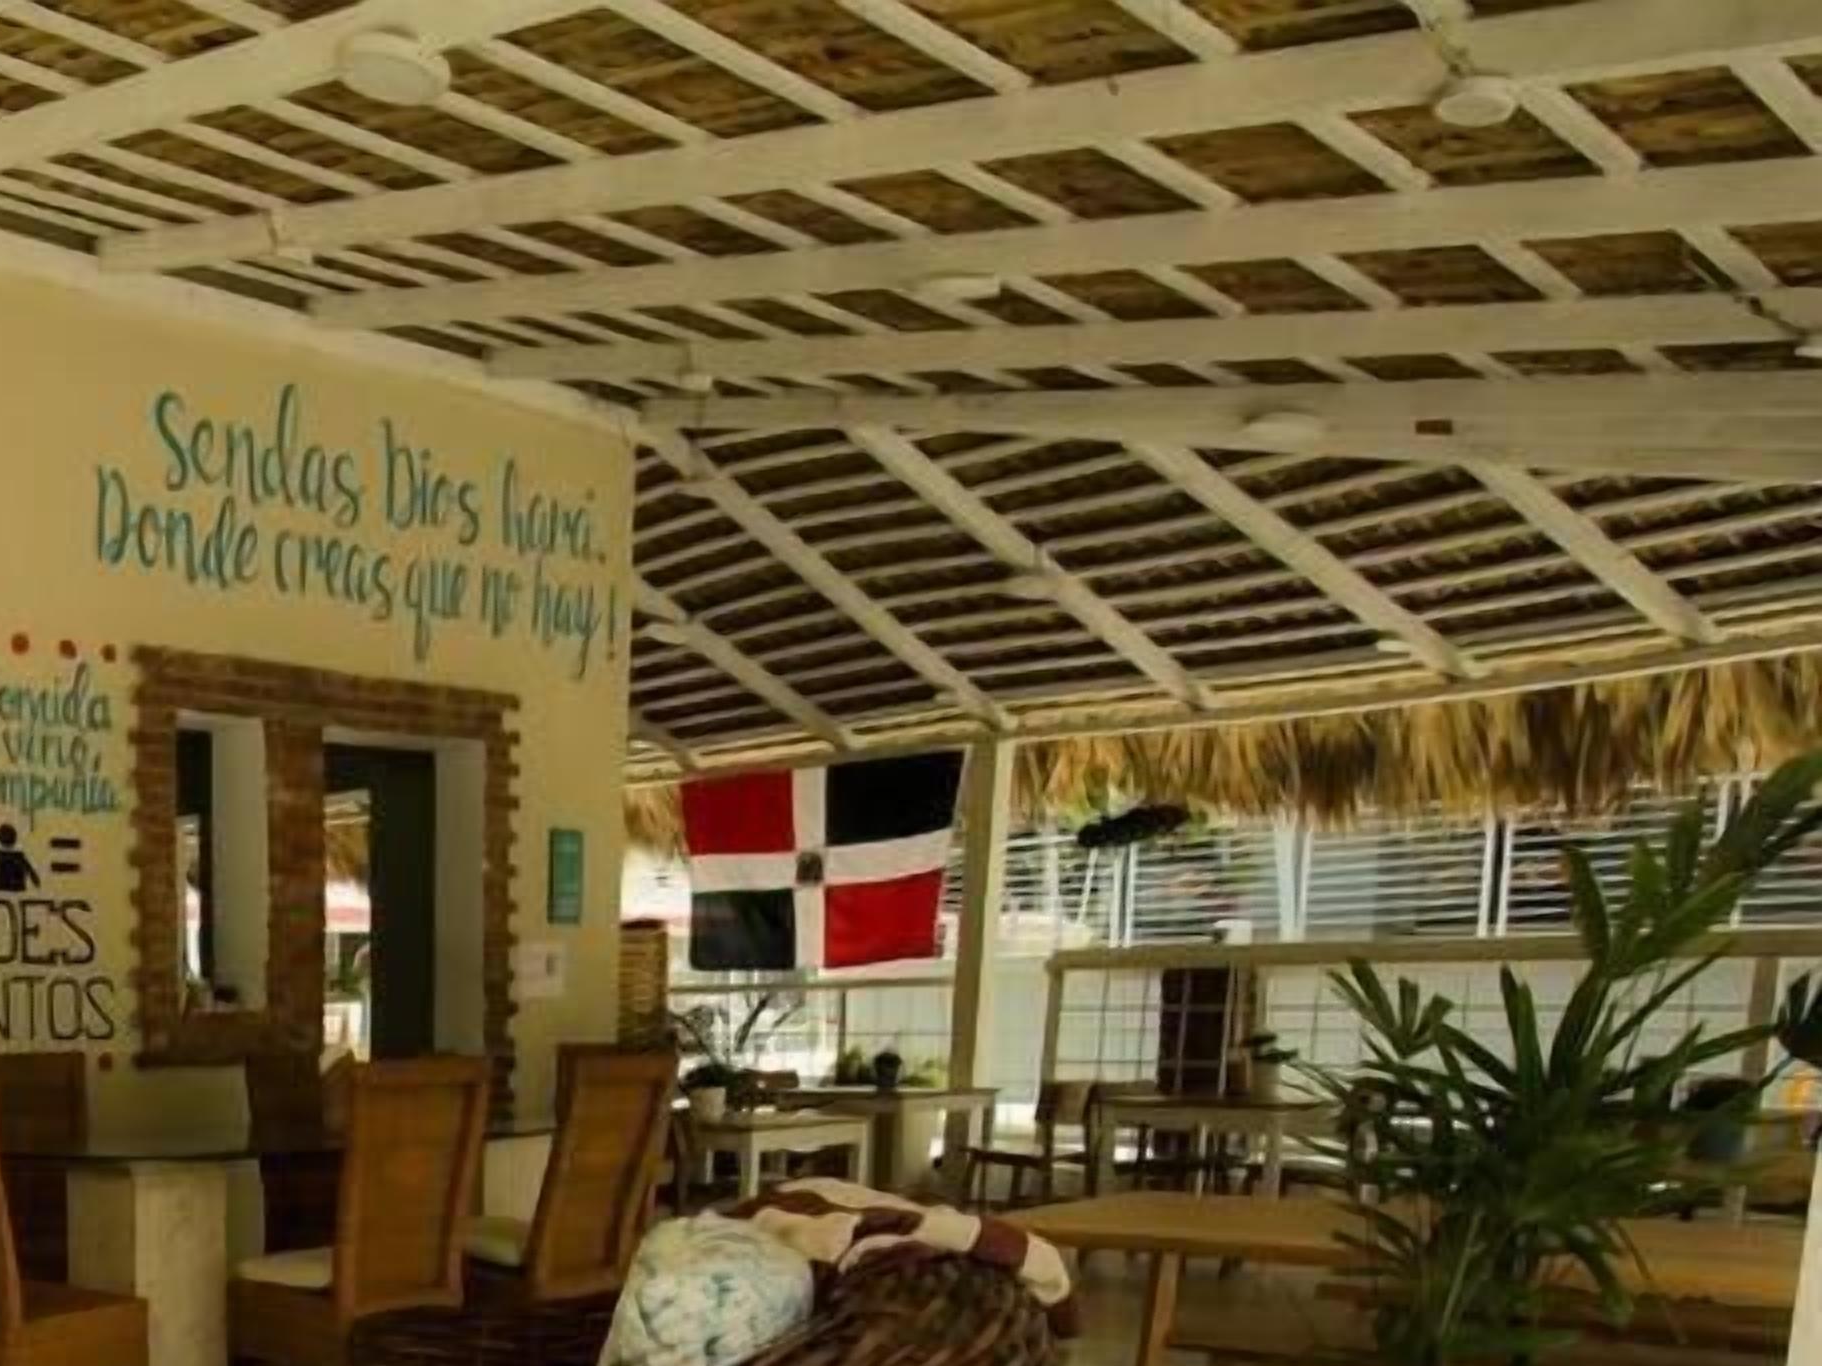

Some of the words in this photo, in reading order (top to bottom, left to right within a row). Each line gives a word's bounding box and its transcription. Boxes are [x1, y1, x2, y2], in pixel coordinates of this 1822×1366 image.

[153, 383, 362, 529] Sendas
[96, 465, 259, 589] Donde
[274, 529, 393, 620] creas
[406, 556, 469, 662] que
[481, 562, 516, 638] no
[1, 728, 89, 770] vino
